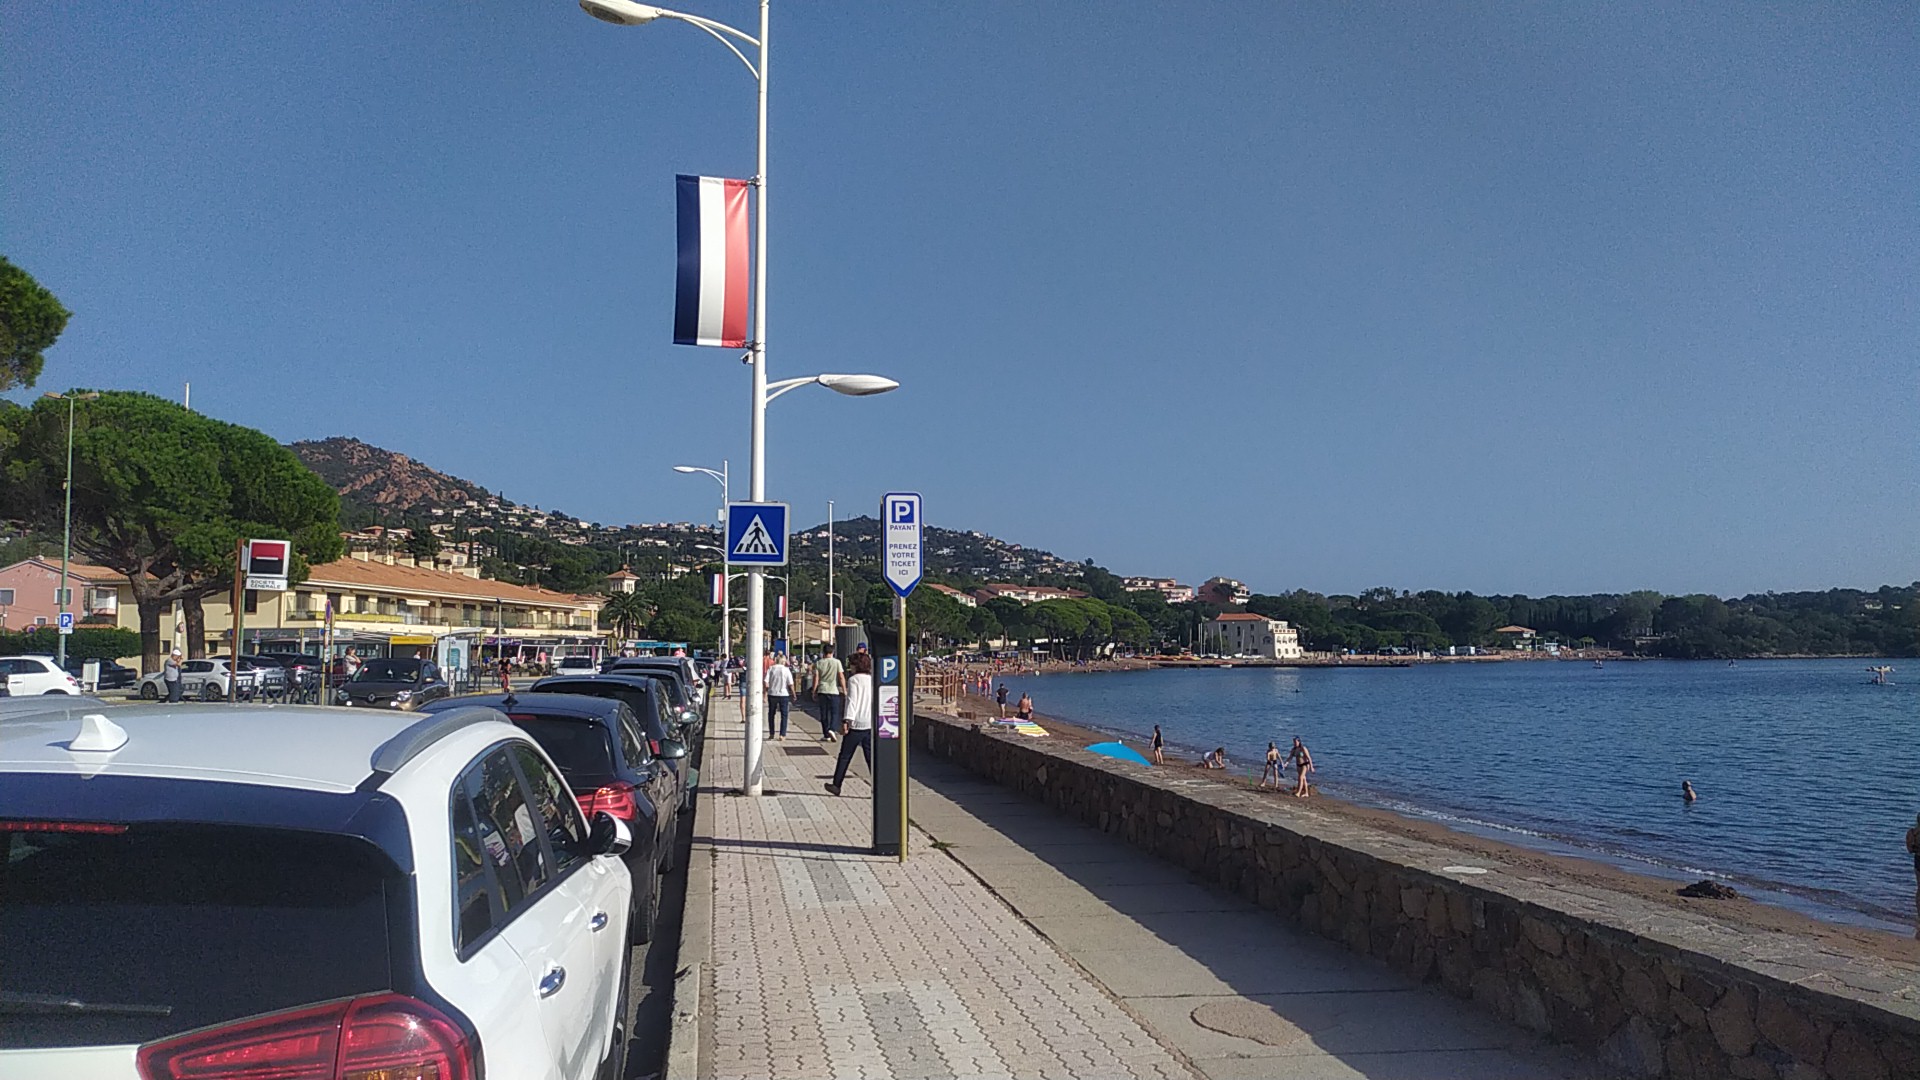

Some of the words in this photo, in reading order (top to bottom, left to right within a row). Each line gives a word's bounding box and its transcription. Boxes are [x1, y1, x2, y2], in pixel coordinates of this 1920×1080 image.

[895, 502, 911, 522] P
[62, 616, 70, 626] P
[883, 658, 896, 678] P
